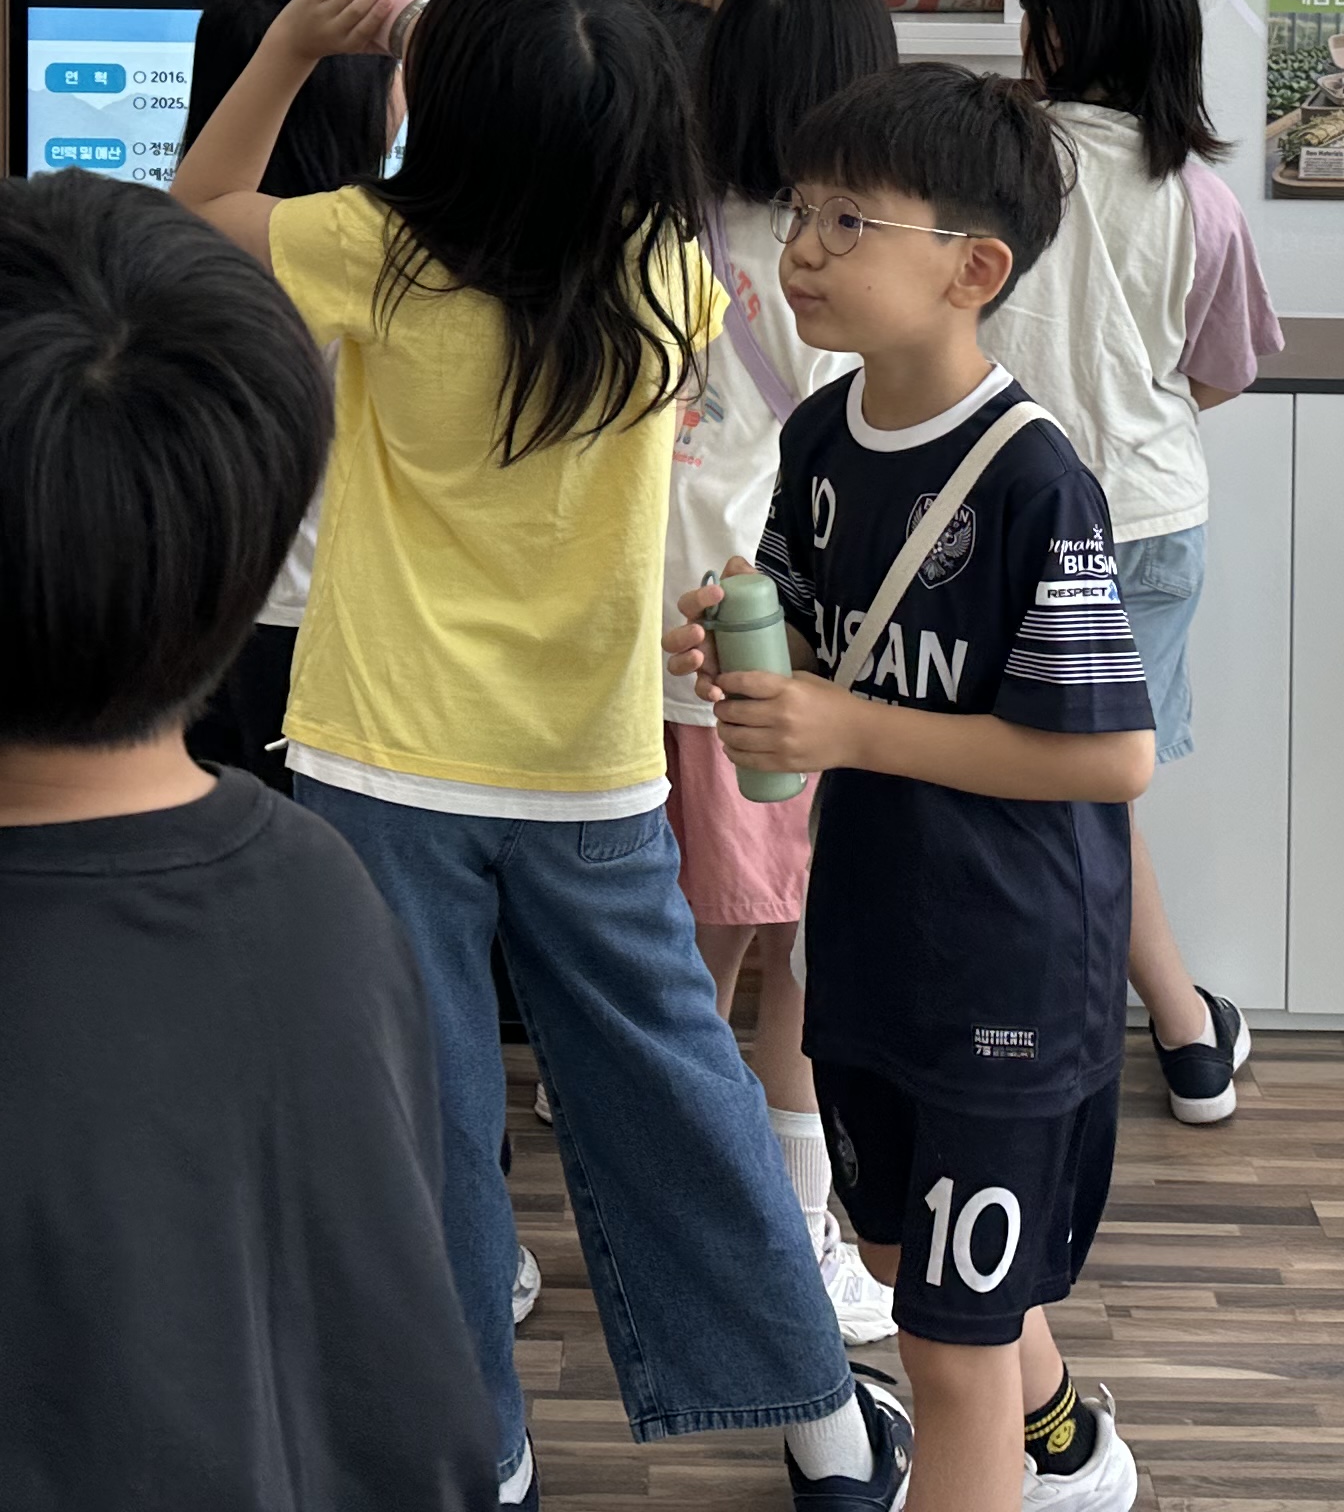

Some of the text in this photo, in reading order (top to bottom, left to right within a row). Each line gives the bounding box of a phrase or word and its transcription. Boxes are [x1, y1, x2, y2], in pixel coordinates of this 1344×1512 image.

[151, 71, 186, 83] 2016.
[151, 97, 188, 110] 2025.
[50, 145, 78, 161] 인력
[78, 145, 93, 161] 및
[1047, 587, 1108, 599] RESPECT
[974, 1028, 1035, 1047] AUTHENTIC
[924, 1177, 1022, 1294] 10
